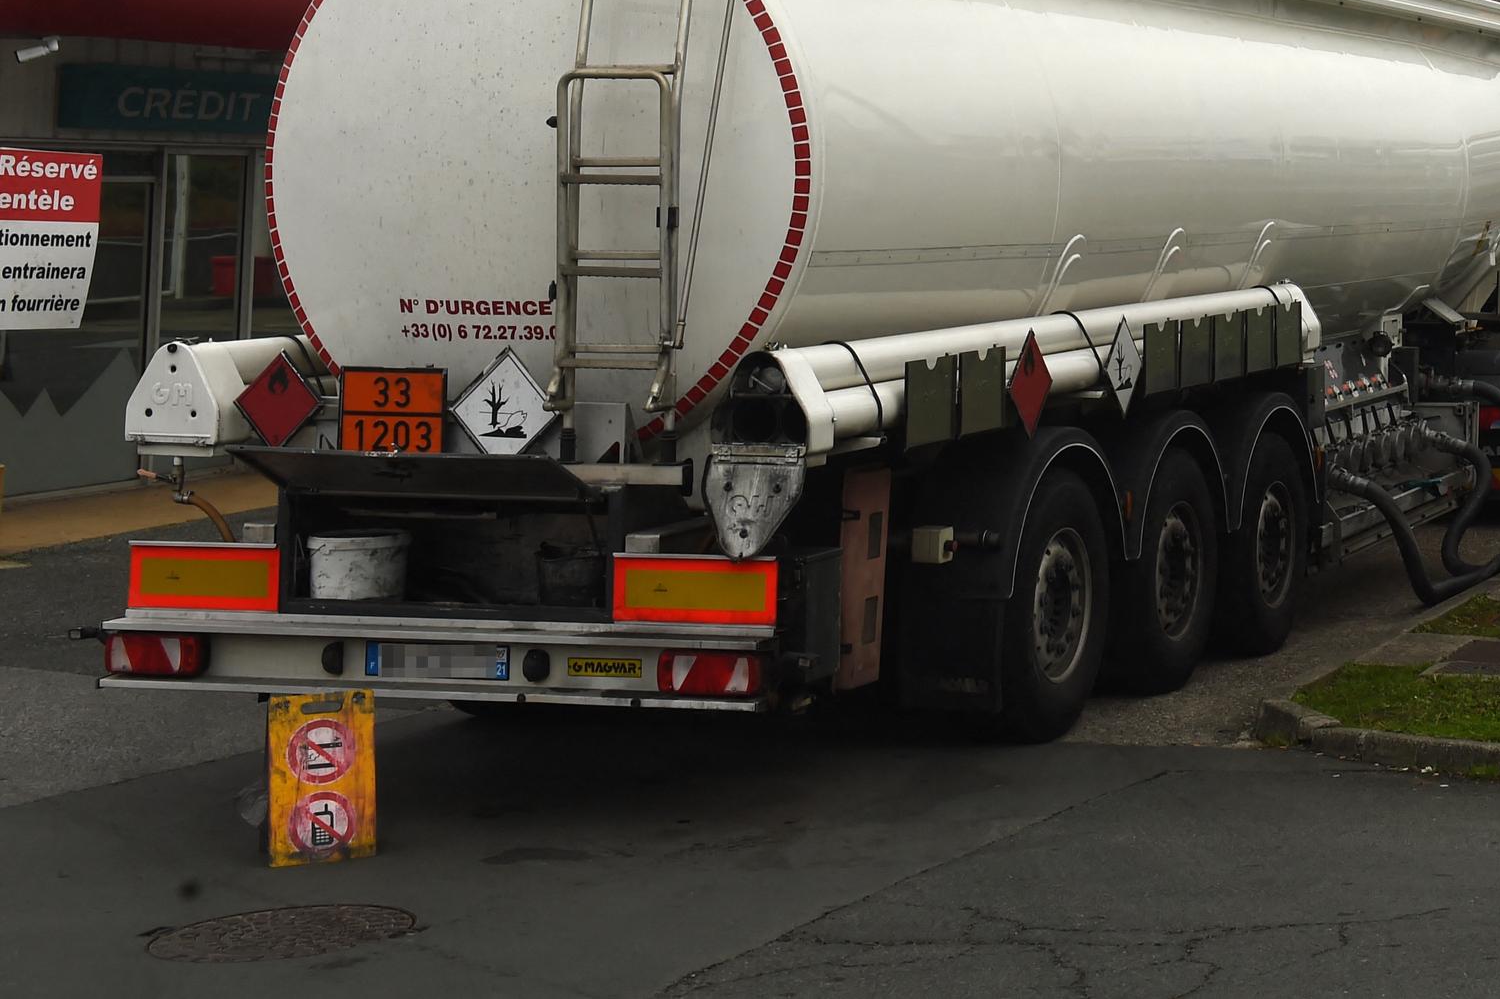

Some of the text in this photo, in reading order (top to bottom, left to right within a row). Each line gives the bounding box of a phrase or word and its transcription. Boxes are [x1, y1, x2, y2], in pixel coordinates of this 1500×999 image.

[117, 82, 262, 121] CRÉDIT
[0, 154, 98, 180] Réservé
[0, 188, 75, 211] entèle
[0, 228, 92, 248] tionnement
[1, 262, 87, 280] entrainera
[11, 294, 80, 312] fourrière
[400, 298, 420, 314] N°
[458, 324, 468, 339] 6
[373, 376, 412, 409] 33
[354, 419, 433, 452] 1203
[496, 664, 506, 676] 21
[584, 662, 637, 675] MAGYAR
